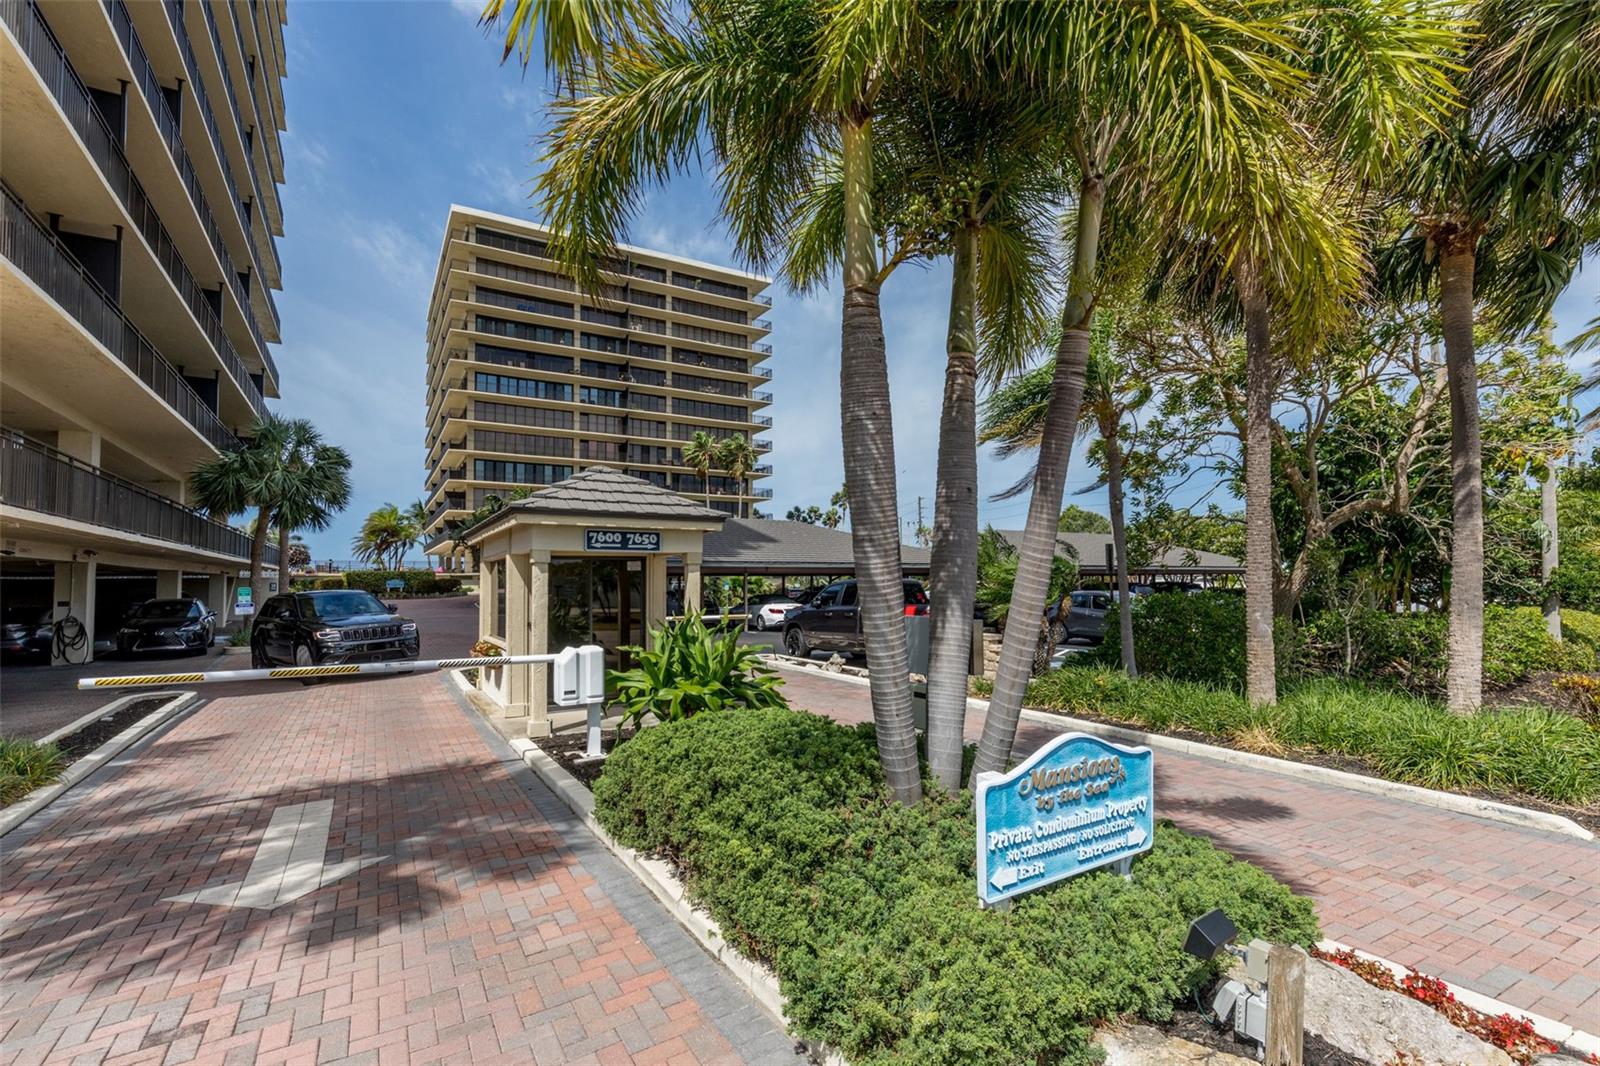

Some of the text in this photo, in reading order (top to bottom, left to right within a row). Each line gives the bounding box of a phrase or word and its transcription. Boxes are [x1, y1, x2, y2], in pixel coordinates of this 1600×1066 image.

[588, 531, 658, 545] 7600 7650
[1019, 755, 1120, 796] Mansions
[1084, 781, 1109, 797] Sea
[988, 796, 1148, 851] Private Condominium Property
[1006, 848, 1021, 862] NO
[1021, 832, 1076, 857] TRESPASSING
[1080, 828, 1094, 841] NO
[1094, 815, 1135, 838] SOLICITING
[1077, 837, 1127, 860] Entrance
[1018, 861, 1045, 879] Exit
